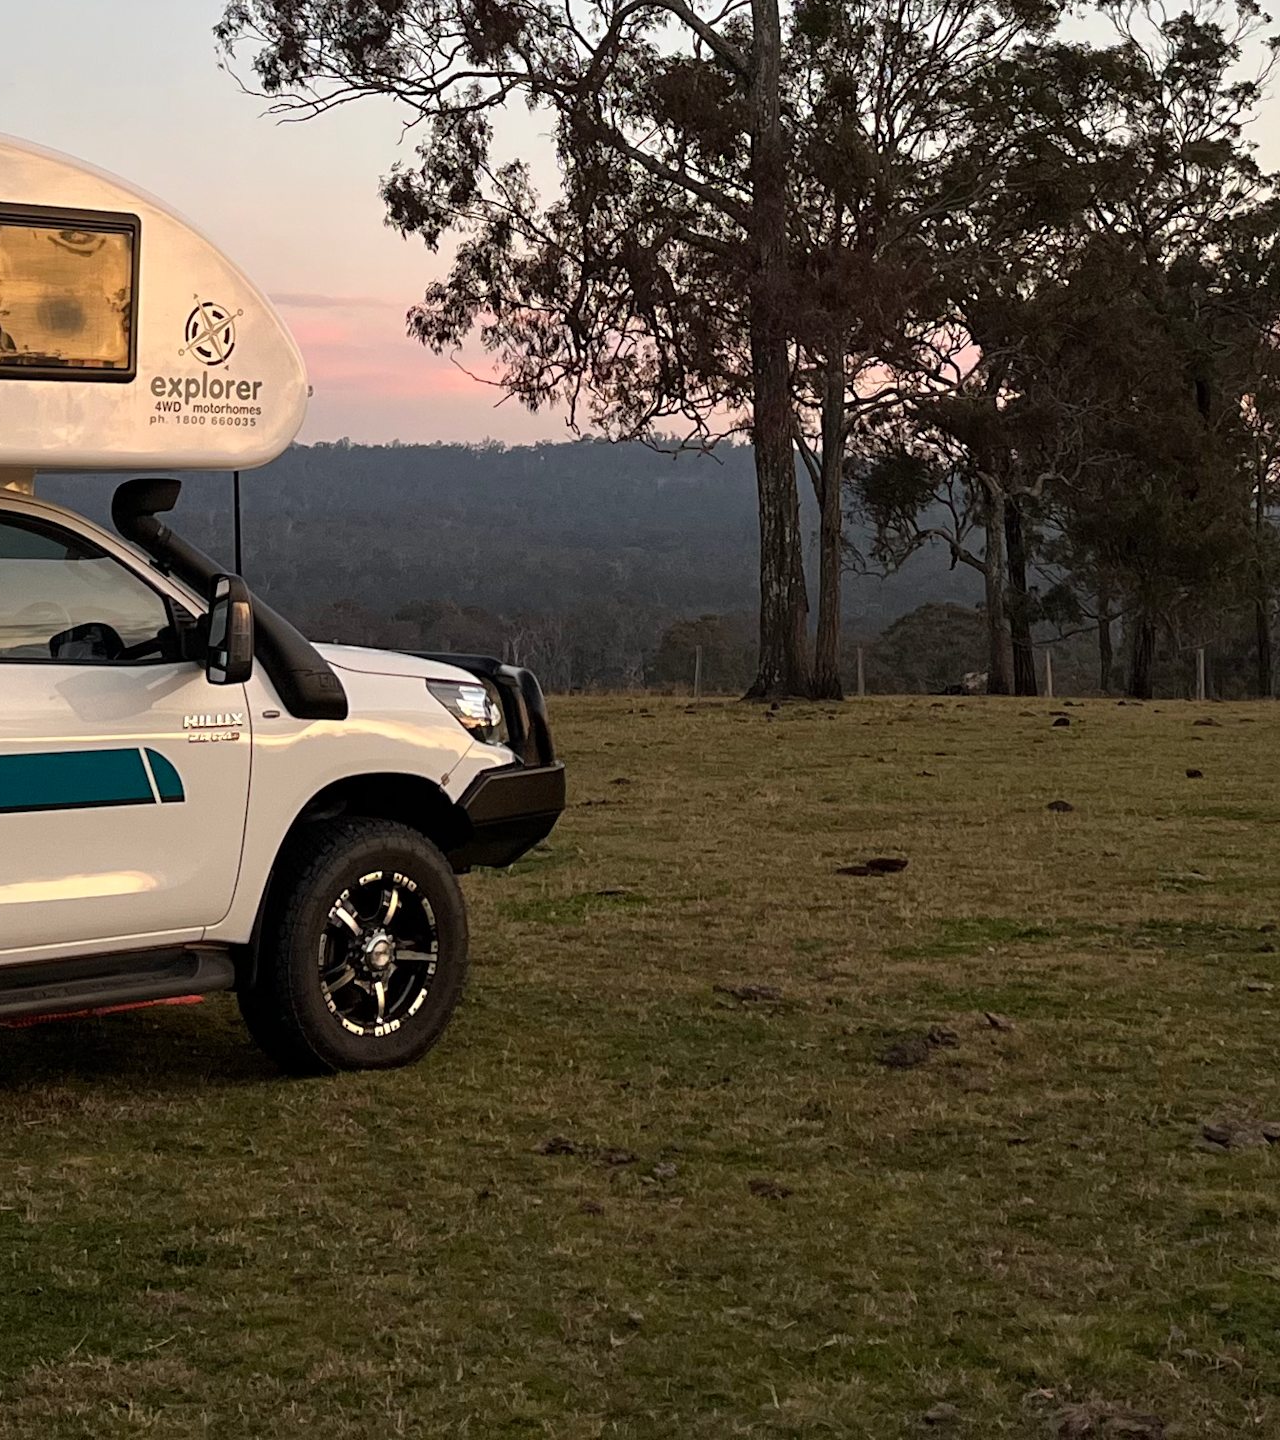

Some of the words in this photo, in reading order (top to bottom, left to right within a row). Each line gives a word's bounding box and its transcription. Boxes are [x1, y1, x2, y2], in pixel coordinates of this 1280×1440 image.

[150, 371, 263, 405] explorer
[155, 401, 181, 413] 4WD
[193, 403, 261, 415] motorhomes
[176, 415, 205, 424] 1800
[183, 712, 243, 729] HILUX
